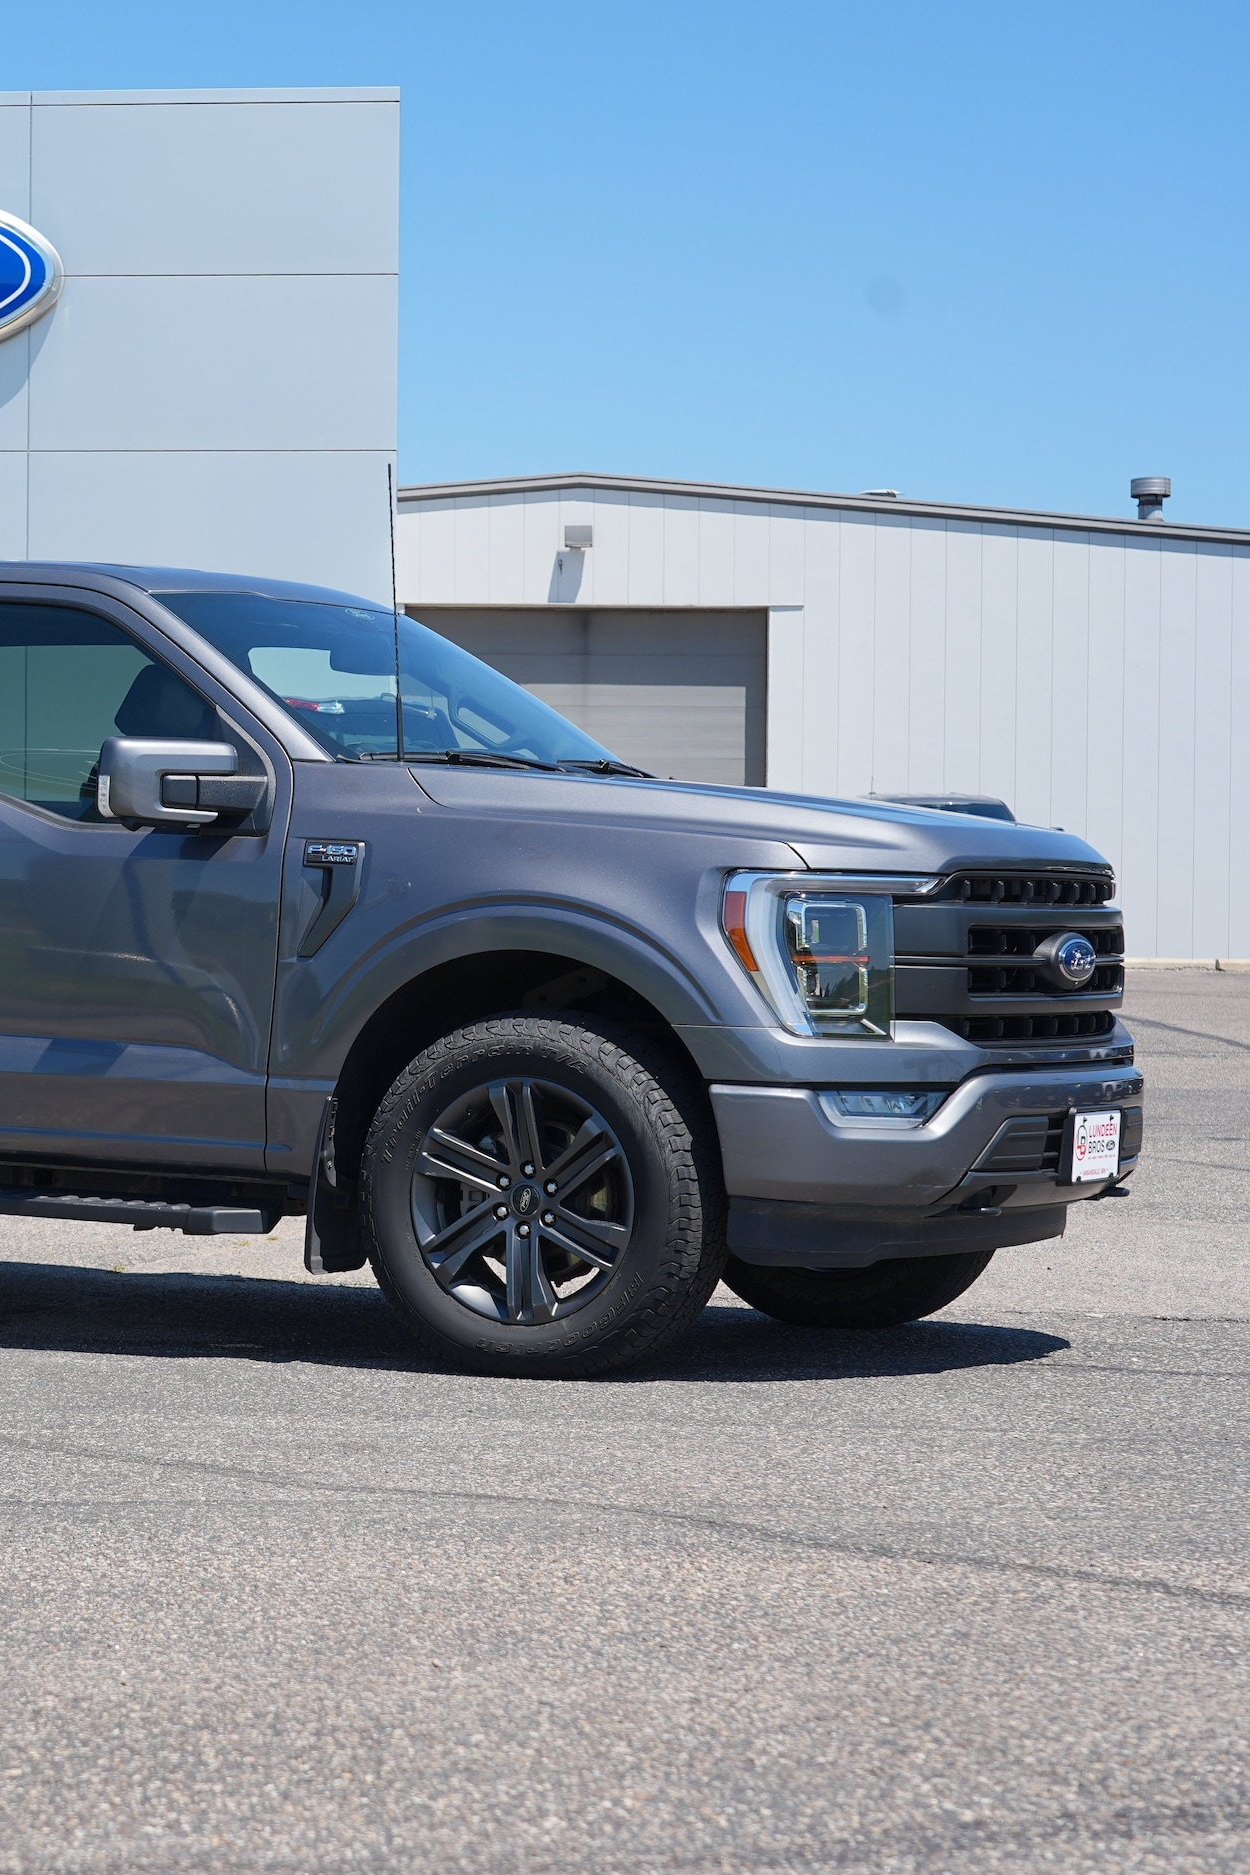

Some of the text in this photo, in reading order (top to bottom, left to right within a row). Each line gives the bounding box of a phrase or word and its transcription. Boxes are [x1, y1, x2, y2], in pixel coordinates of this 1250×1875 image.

[307, 844, 357, 856] F-150
[322, 855, 354, 863] LARIAT
[1089, 1123, 1118, 1138] LUNDEEN
[1088, 1140, 1105, 1154] BROS
